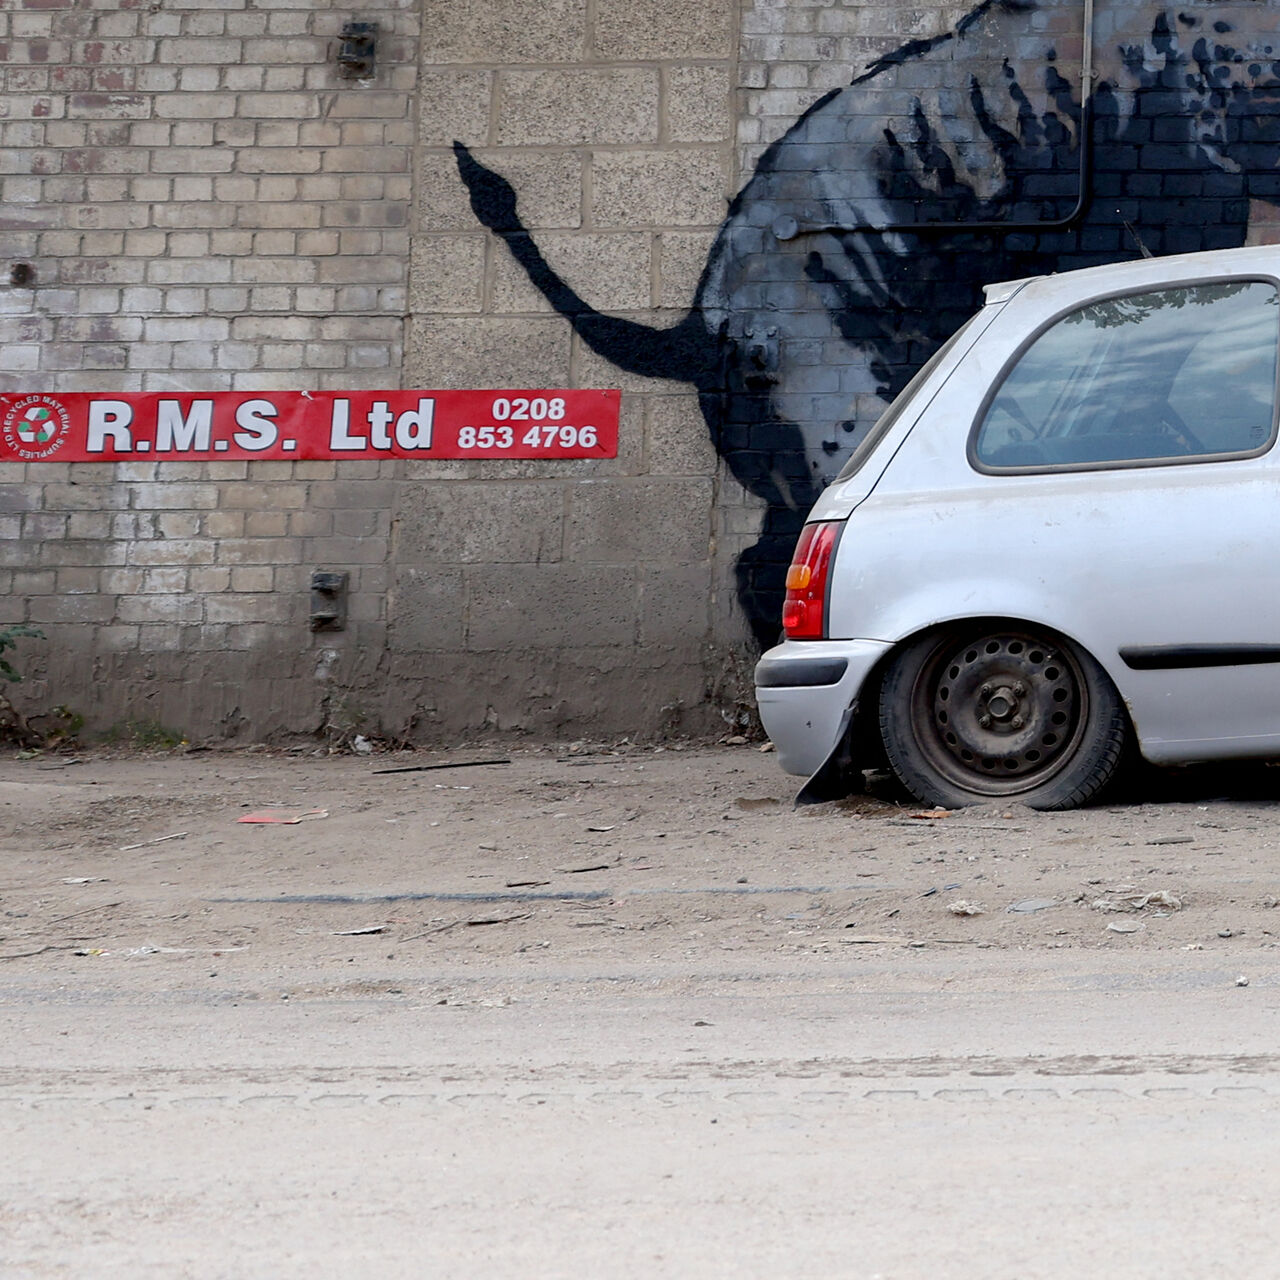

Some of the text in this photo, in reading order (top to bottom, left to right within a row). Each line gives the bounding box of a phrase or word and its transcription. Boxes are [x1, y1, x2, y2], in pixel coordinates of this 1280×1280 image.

[3, 395, 40, 433] RECYCLED
[492, 398, 565, 421] 0208
[86, 398, 434, 453] R.M.S. Ltd
[458, 425, 597, 450] 853 4796
[4, 434, 20, 451] LTD
